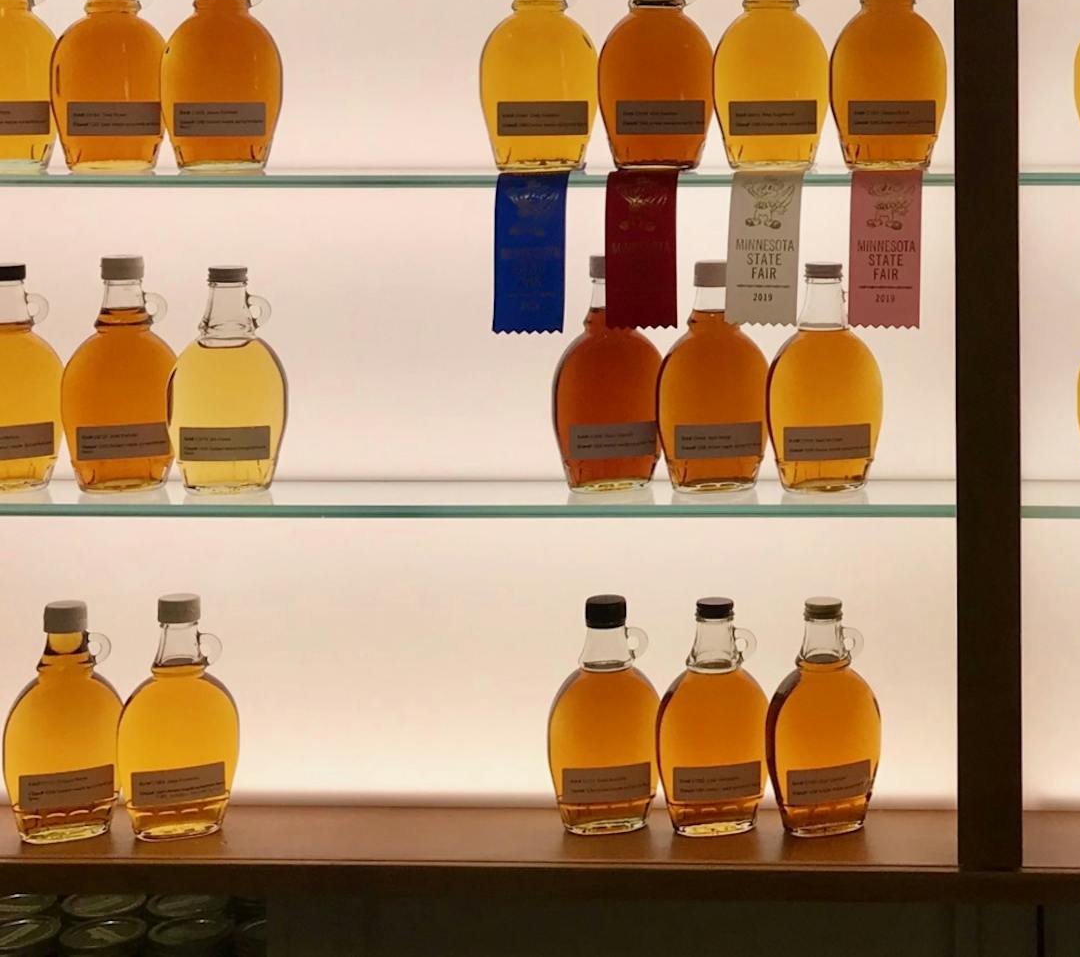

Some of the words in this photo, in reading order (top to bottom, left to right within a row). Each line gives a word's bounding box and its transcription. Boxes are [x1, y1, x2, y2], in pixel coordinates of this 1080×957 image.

[735, 239, 795, 252] MINNESOTA
[857, 239, 916, 253] MINNESOTA
[746, 252, 782, 266] STATE
[868, 253, 904, 267] STATE
[751, 267, 777, 280] FAIR
[873, 268, 899, 281] FAIR
[752, 292, 773, 302] 2019
[875, 293, 896, 303] 2019
